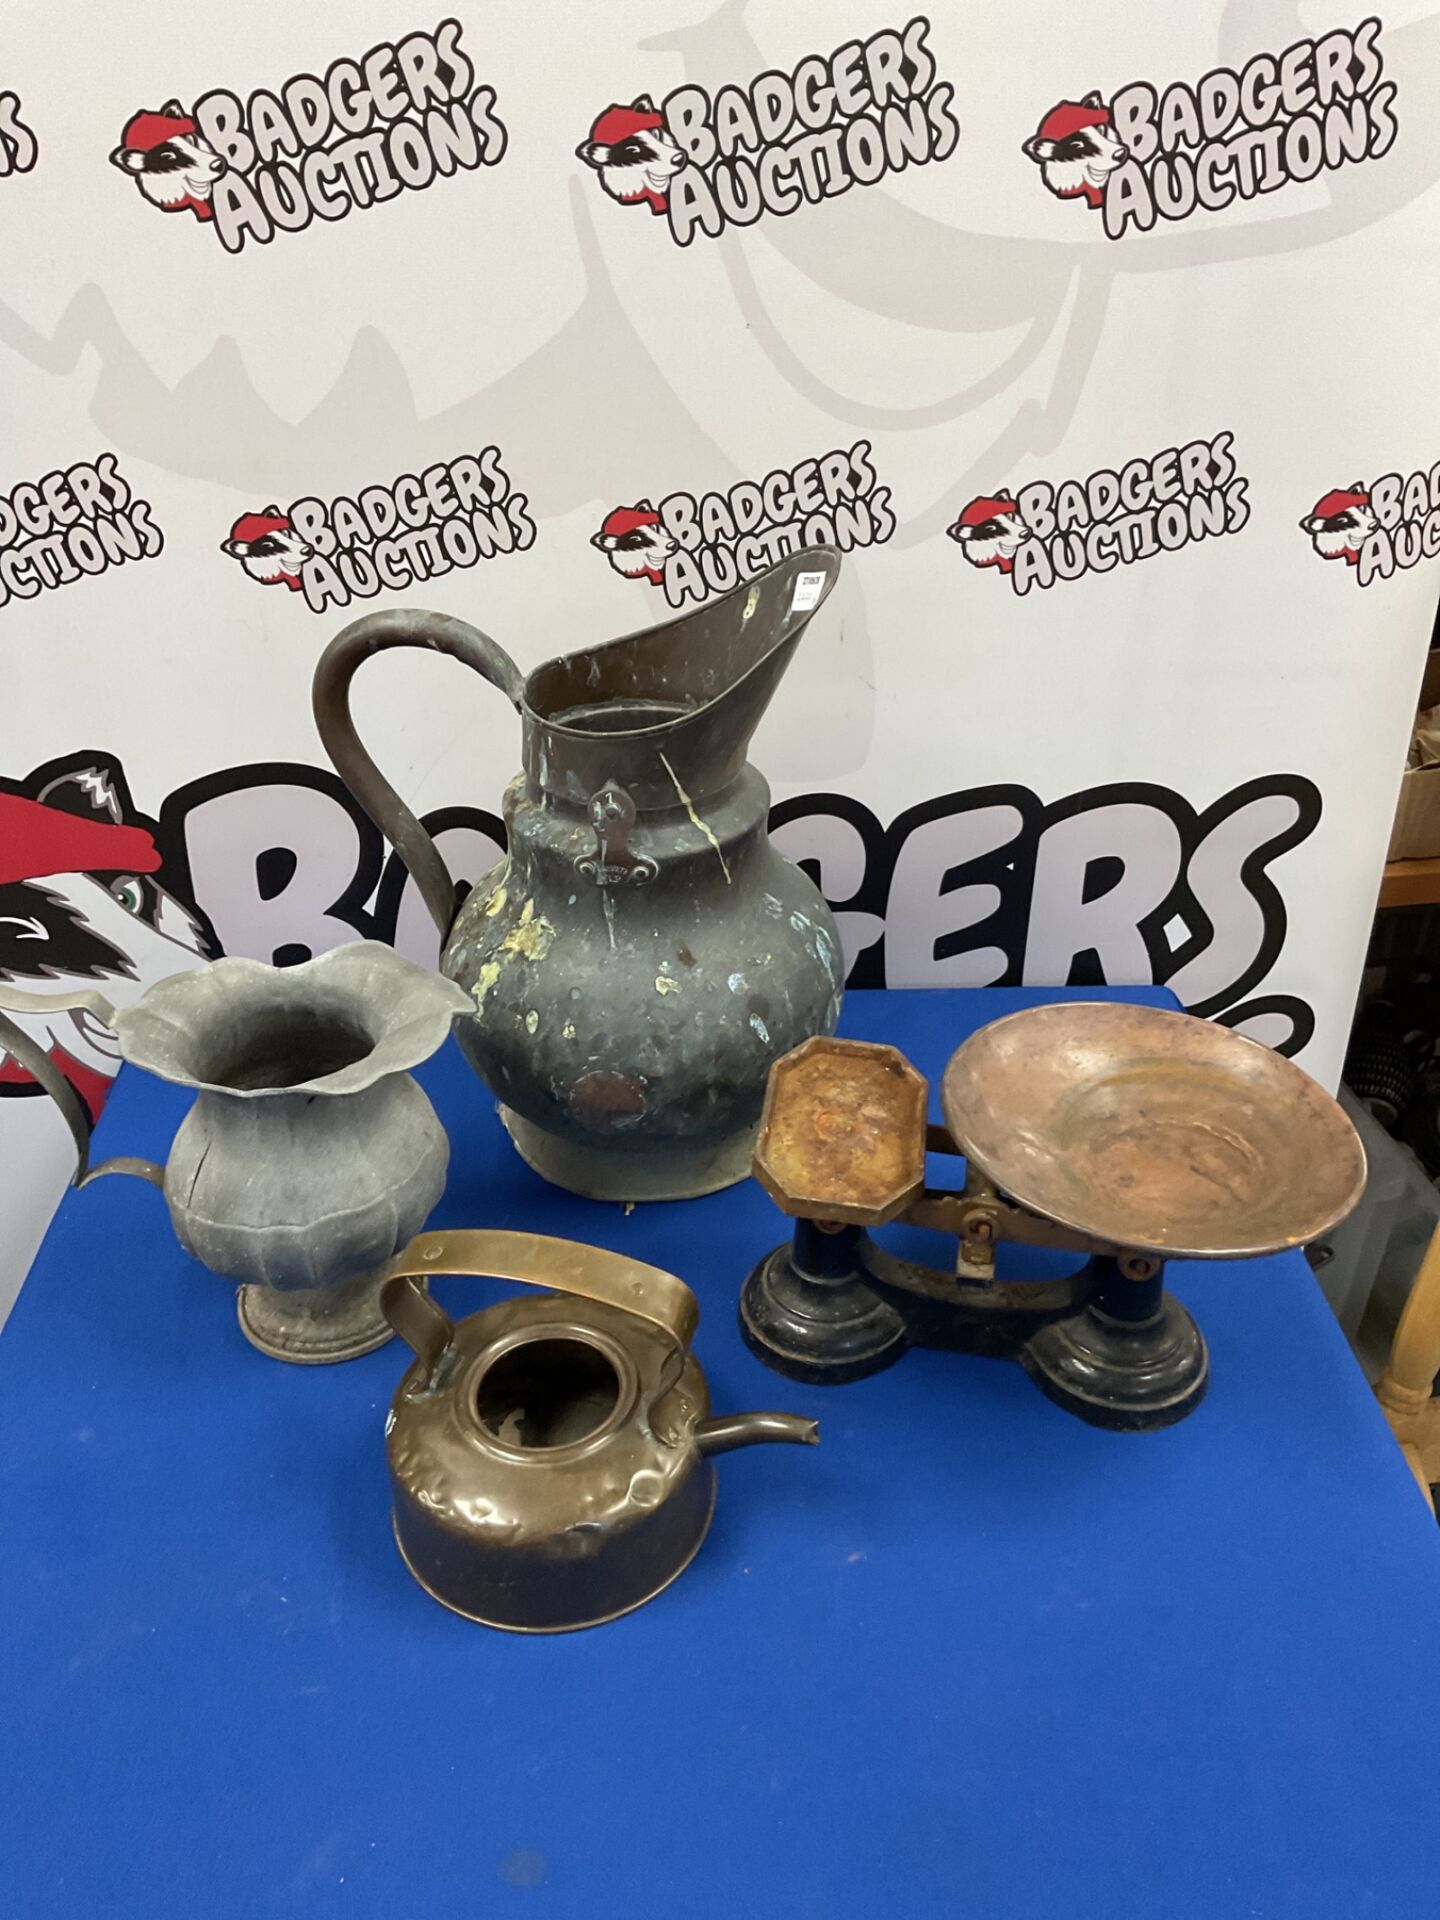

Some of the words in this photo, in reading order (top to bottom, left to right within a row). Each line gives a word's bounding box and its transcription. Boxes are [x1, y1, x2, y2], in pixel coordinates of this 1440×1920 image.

[192, 17, 474, 175] BADGERS
[661, 16, 936, 168] BADGERS
[1110, 16, 1384, 162] BADGERS
[210, 84, 508, 254] AUCTIONS
[667, 81, 960, 247] AUCTIONS
[1102, 81, 1398, 240] AUCTIONS
[288, 445, 511, 559] BADGERS
[658, 440, 877, 554] BADGERS
[1012, 477, 1251, 596] AUCTIONS
[1016, 431, 1236, 541] BADGERS
[0, 499, 164, 608] CTIONS
[301, 493, 537, 613] AUCTIONS
